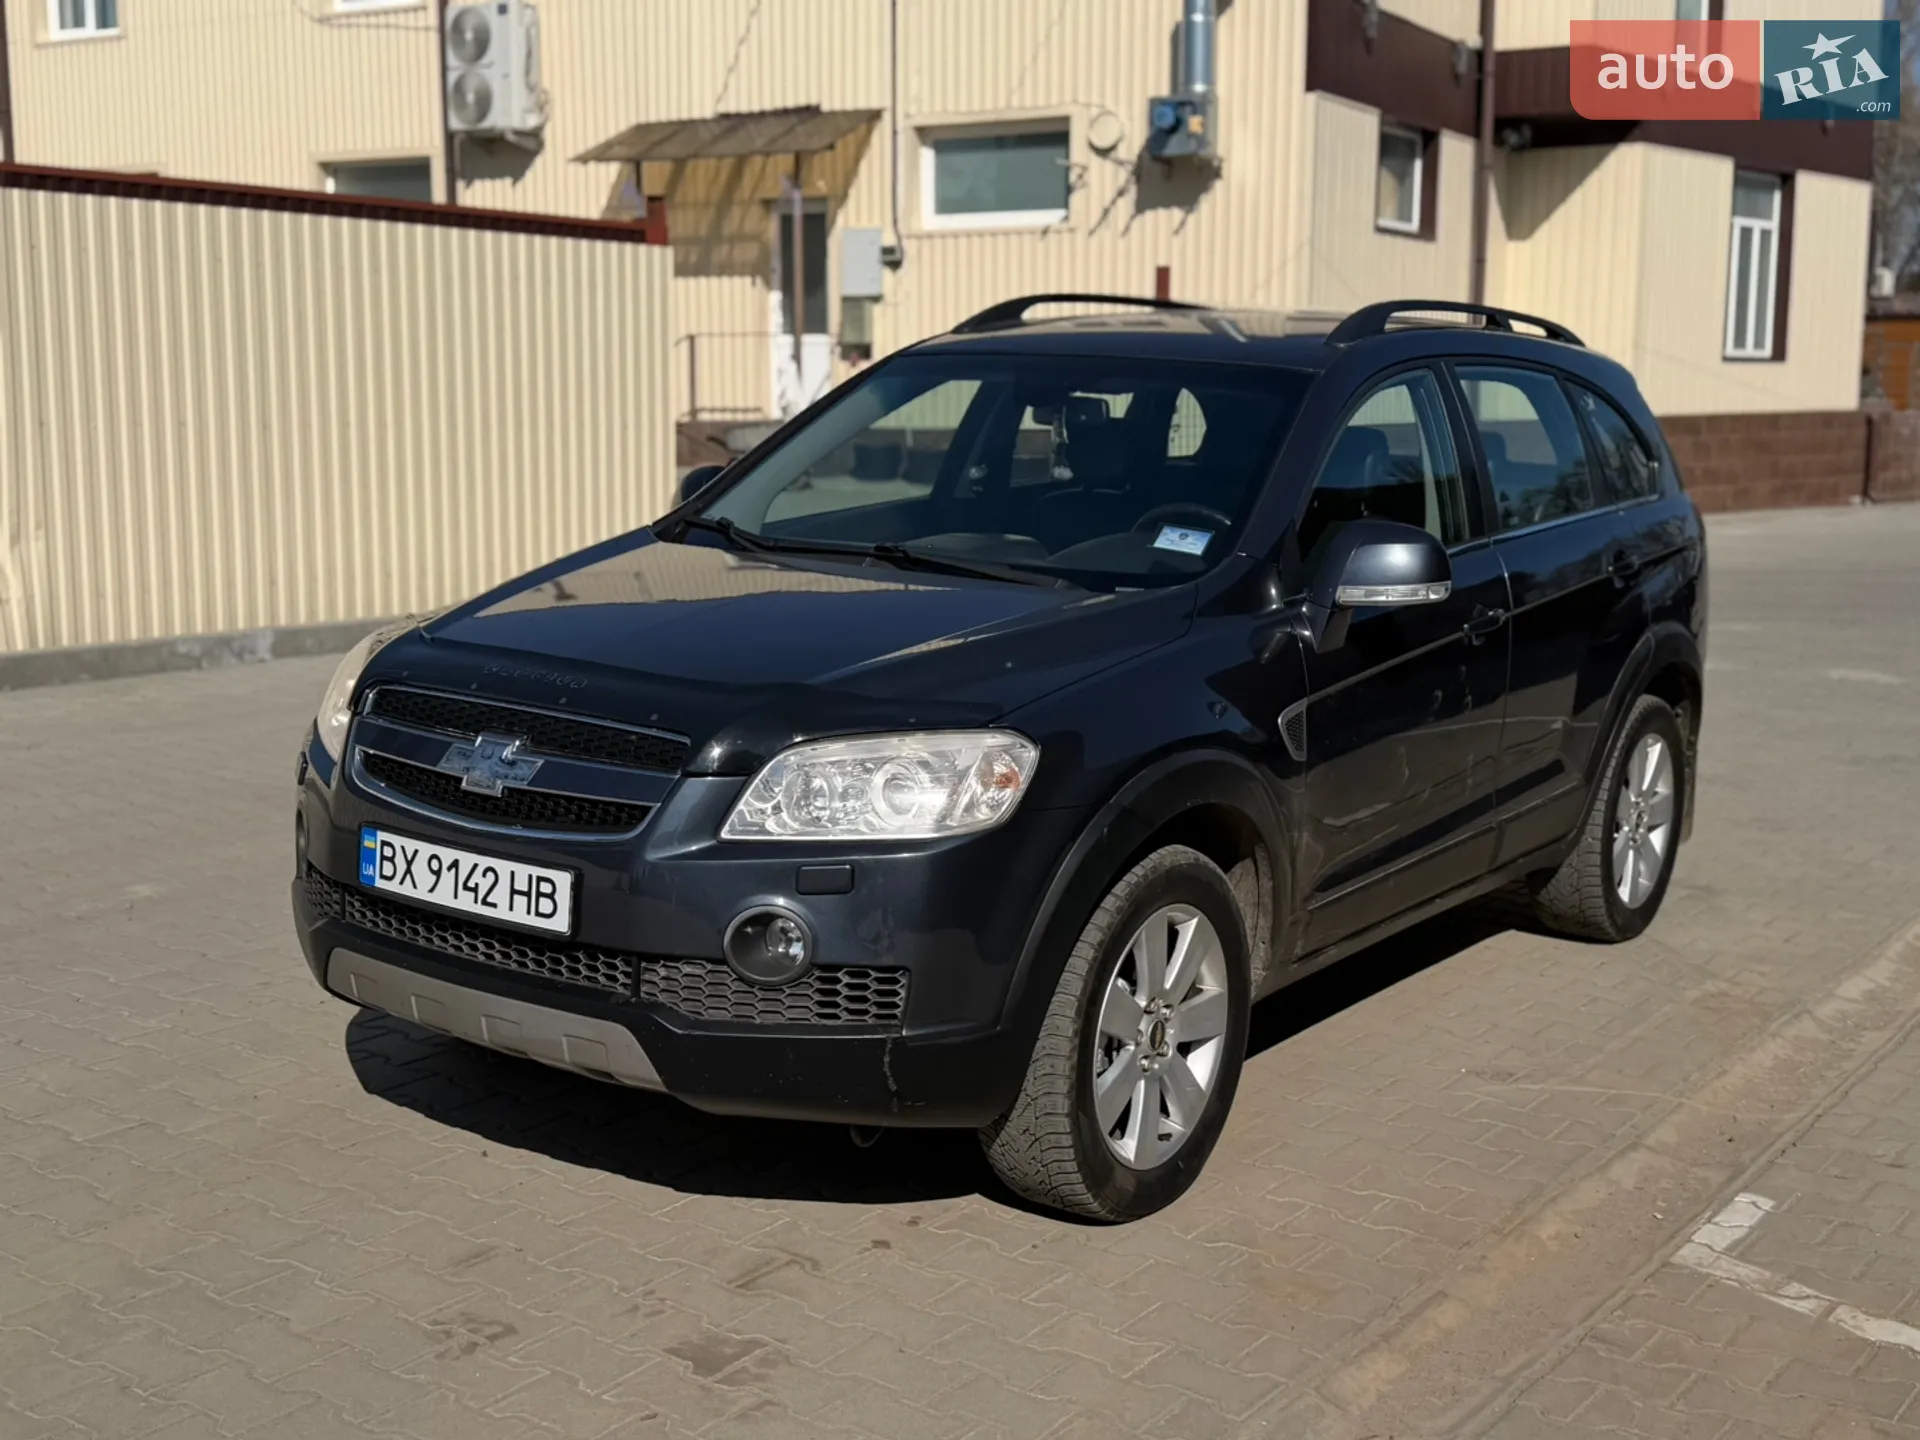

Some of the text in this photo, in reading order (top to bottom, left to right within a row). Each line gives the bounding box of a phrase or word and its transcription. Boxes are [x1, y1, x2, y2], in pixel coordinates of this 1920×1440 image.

[362, 862, 375, 877] UA
[379, 839, 558, 919] BX 9142 HB
